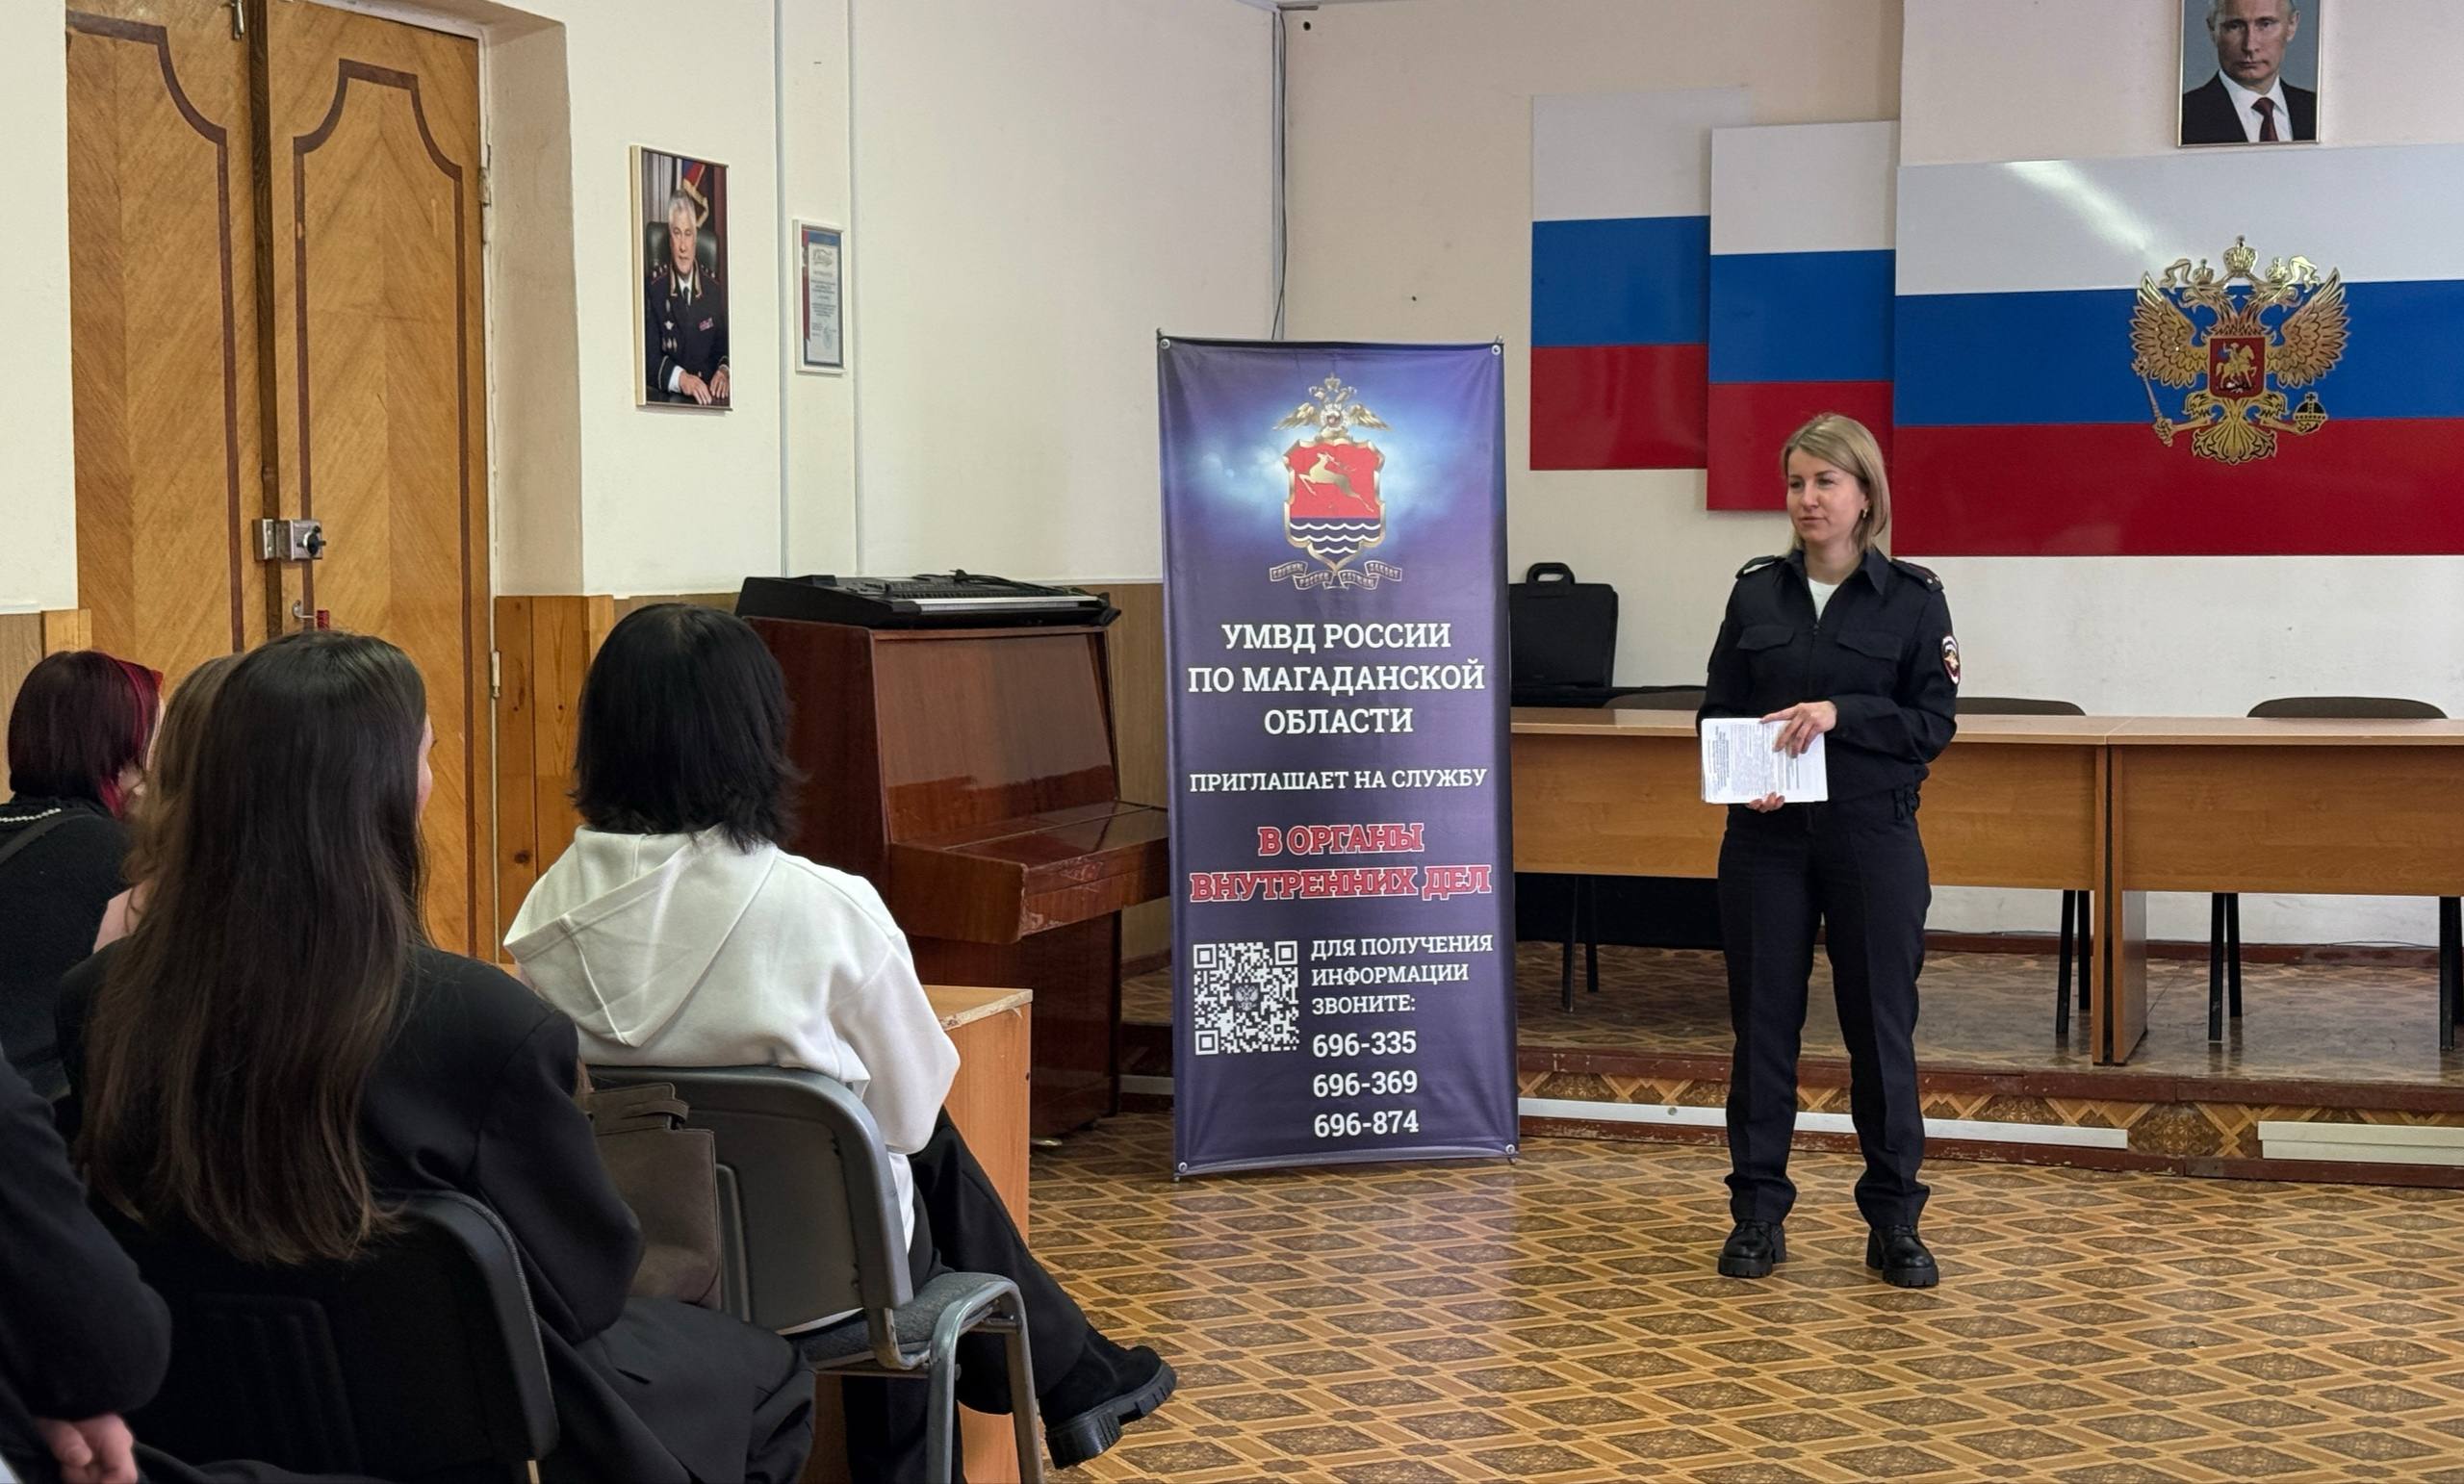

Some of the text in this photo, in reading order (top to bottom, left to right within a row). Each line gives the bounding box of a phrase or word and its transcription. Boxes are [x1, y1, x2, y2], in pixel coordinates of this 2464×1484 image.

[1220, 623, 1452, 654] УМВД РОССИИ
[1187, 658, 1486, 697] ПО МАГАДАНСКОЙ
[1264, 707, 1414, 735] ОБЛАСТИ
[1189, 768, 1488, 794] ПРИГЛАШАЕТ НА СЛУЖБУ
[1257, 822, 1425, 857] В ОРГАНЫ
[1189, 862, 1493, 903] ВНУТРЕННИХ ДЕЛ
[1310, 934, 1494, 961] ДЛЯ ПОЛУЧЕНИЯ
[1311, 963, 1470, 986] ИНФОРМАЦИИ
[1312, 993, 1416, 1015] ЗВОНИТЕ:
[1313, 1030, 1417, 1058] 696-335
[1313, 1069, 1418, 1098] 696-369
[1314, 1109, 1420, 1138] 696-874
